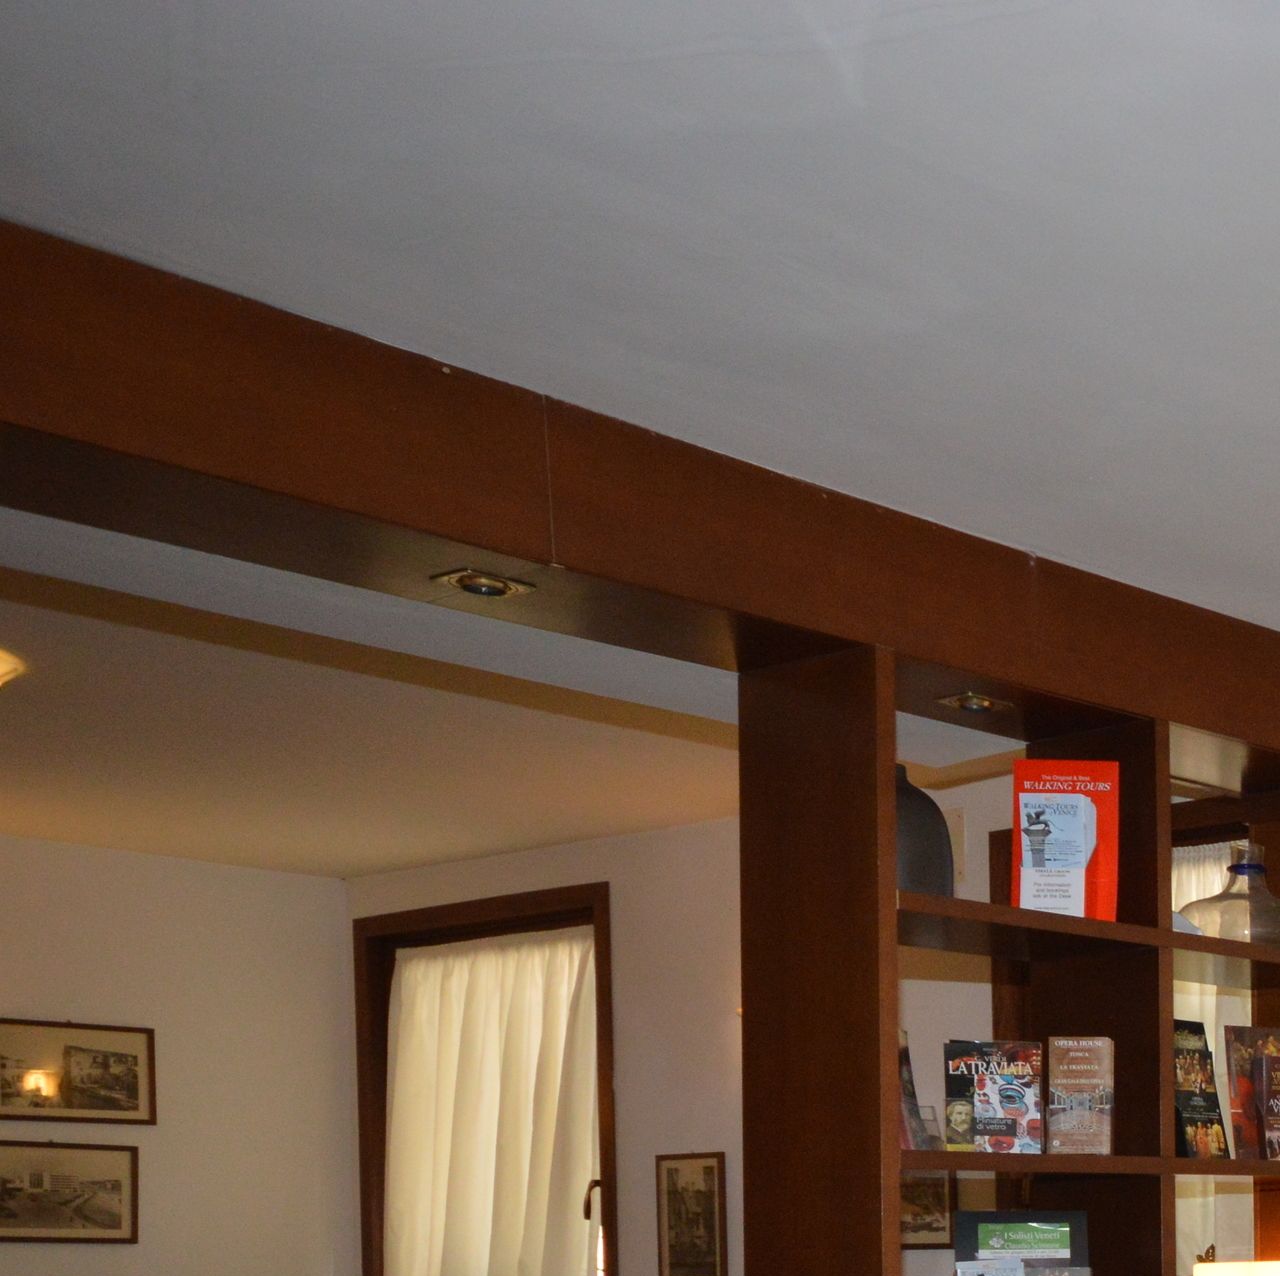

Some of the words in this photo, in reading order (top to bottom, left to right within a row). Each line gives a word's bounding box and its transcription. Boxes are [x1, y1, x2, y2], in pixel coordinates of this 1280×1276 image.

[1023, 781, 1073, 791] WALKING
[1075, 782, 1111, 791] TOURS
[1023, 802, 1054, 810] WALKING
[1055, 1039, 1078, 1047] OPERA
[948, 1060, 969, 1075] LA
[967, 1060, 1034, 1076] TRAVIATA
[1009, 1231, 1034, 1241] Solisti
